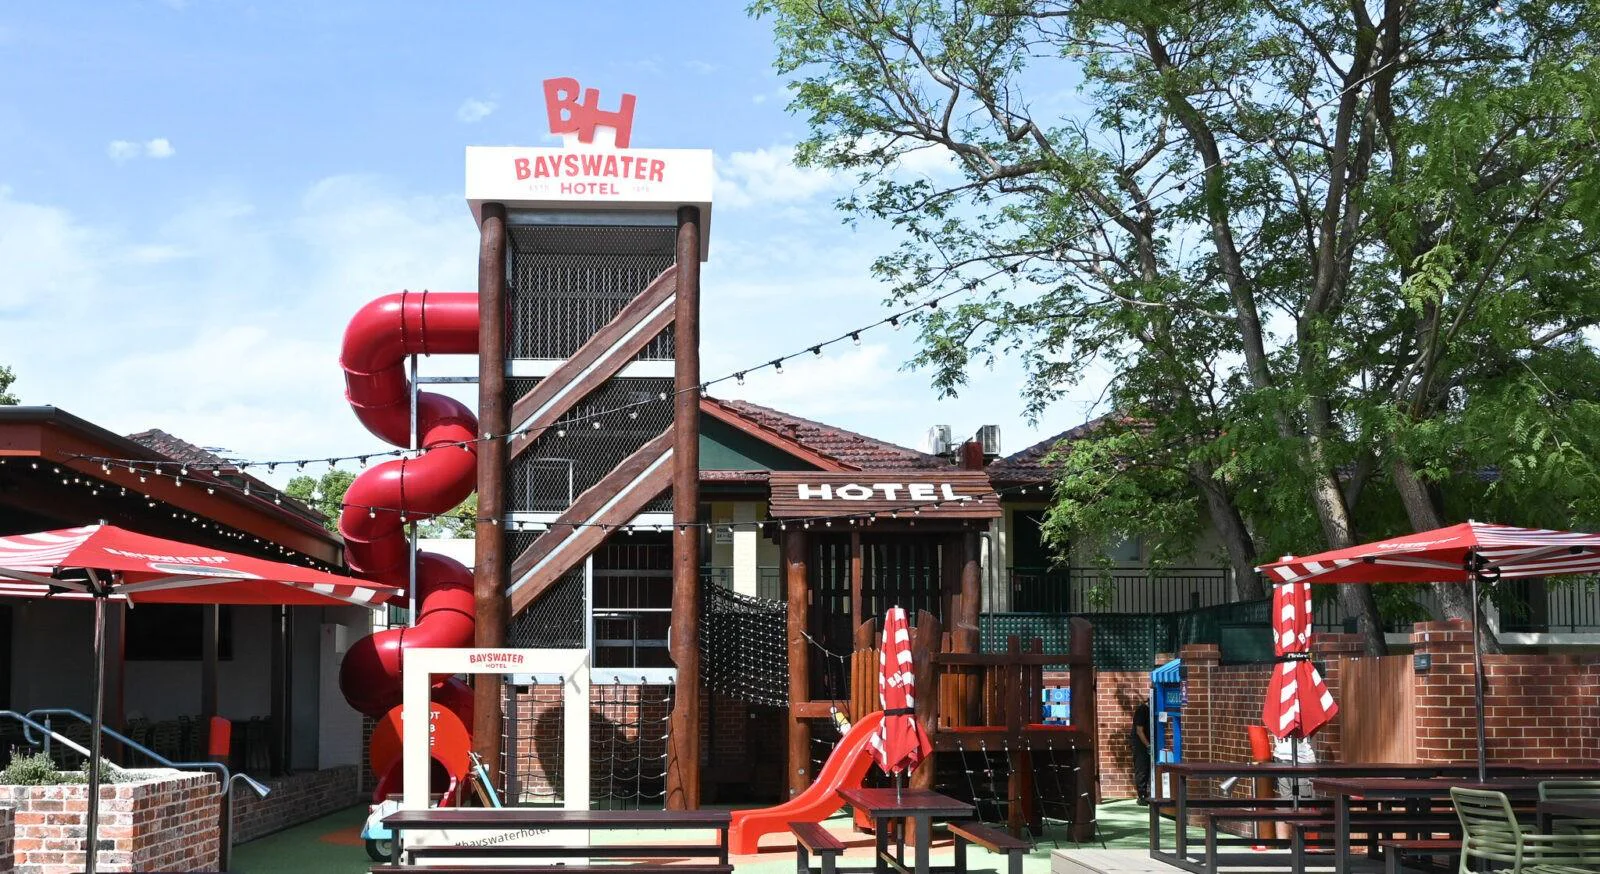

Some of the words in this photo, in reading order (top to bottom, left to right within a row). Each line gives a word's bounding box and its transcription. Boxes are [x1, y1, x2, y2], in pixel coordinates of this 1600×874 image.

[543, 77, 637, 149] BH
[514, 154, 666, 182] BAYSWATER
[560, 182, 620, 195] HOTEL
[797, 483, 972, 501] HOTEL
[469, 653, 524, 664] BAYSWATER
